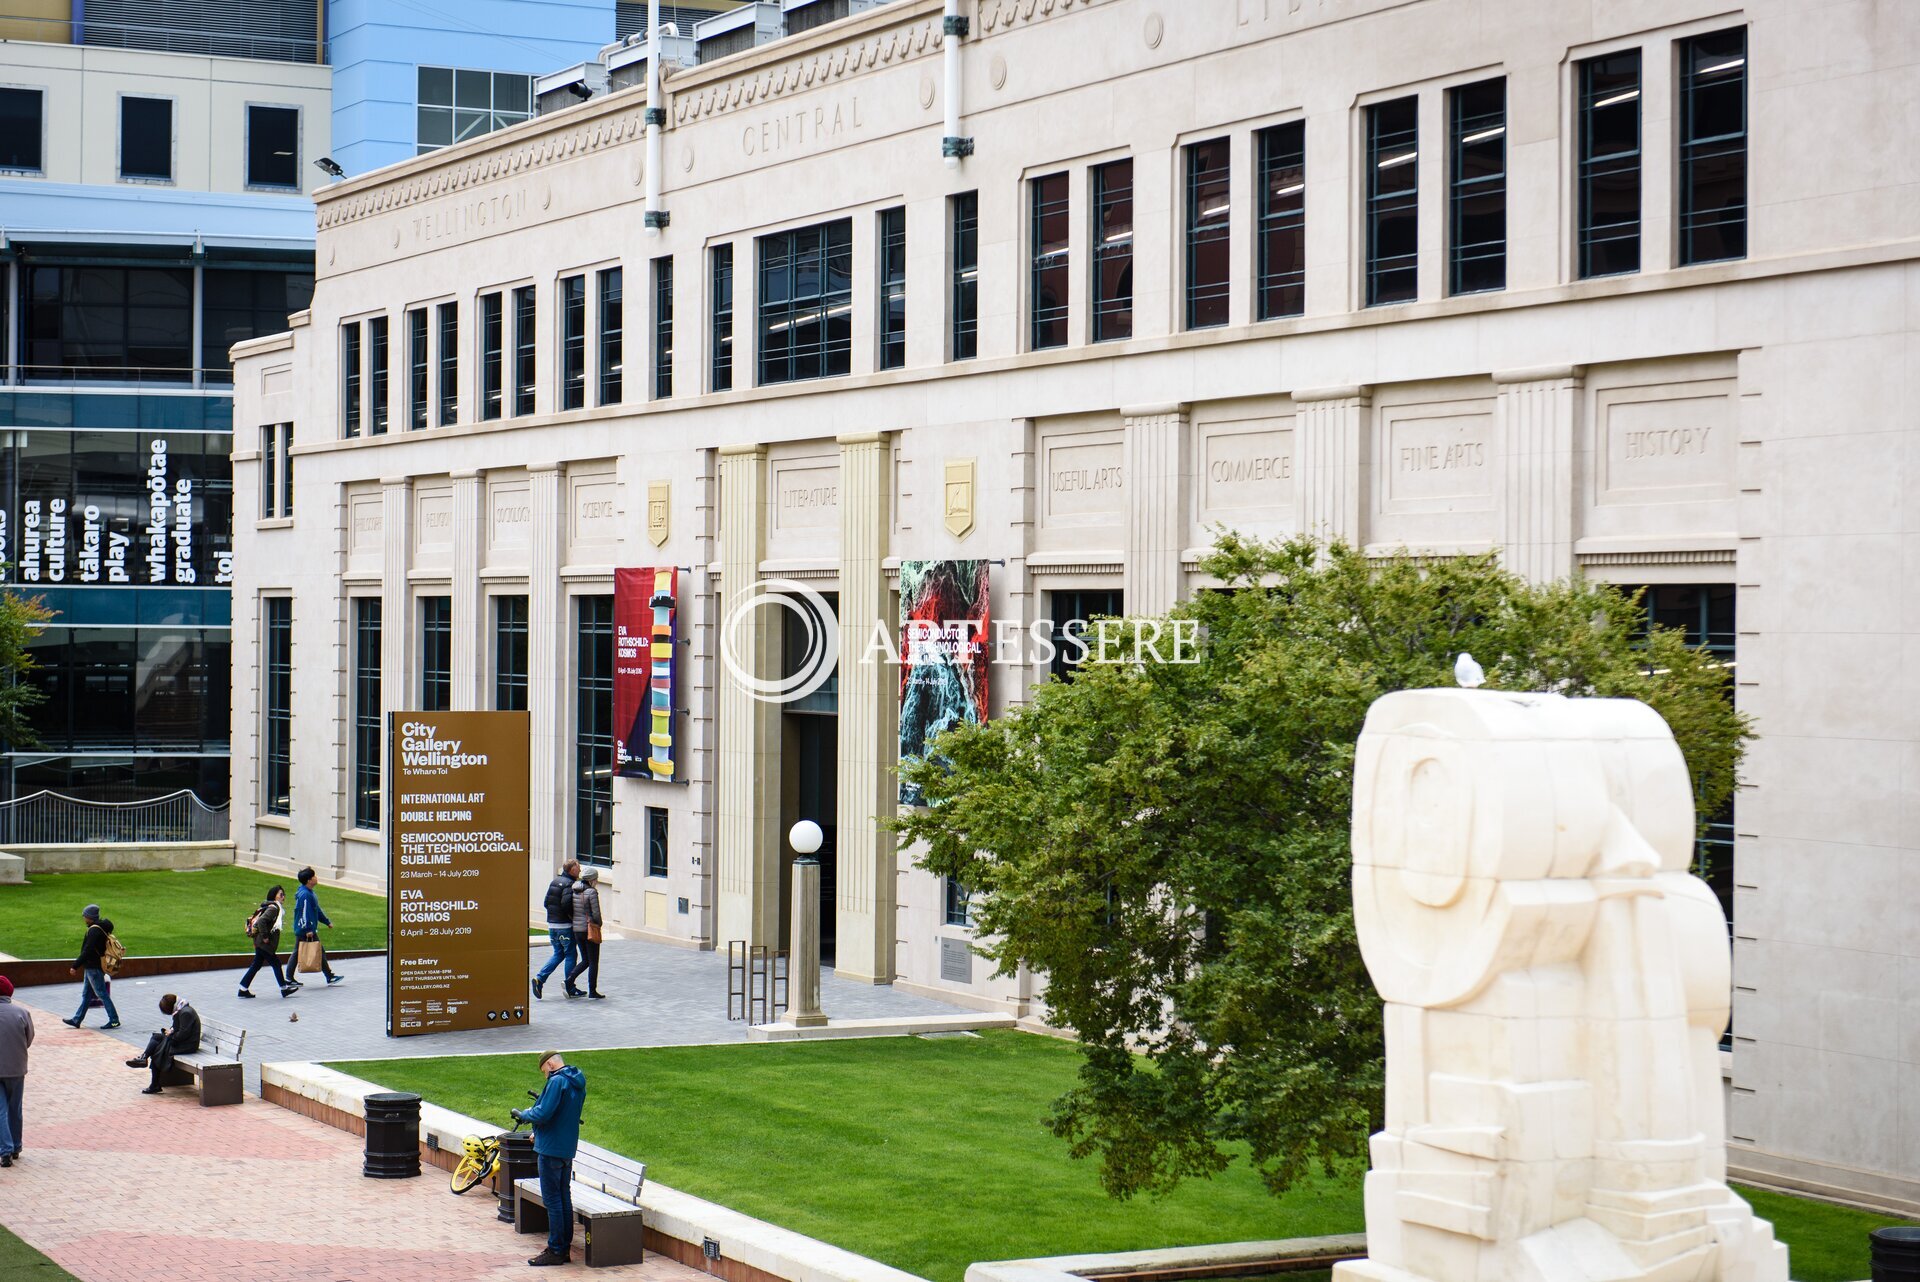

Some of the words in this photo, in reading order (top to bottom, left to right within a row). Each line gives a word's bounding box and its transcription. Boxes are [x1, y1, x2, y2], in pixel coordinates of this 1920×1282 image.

[743, 96, 862, 156] CENTRAL
[413, 189, 526, 240] WELLINGTON
[1625, 427, 1712, 459] HISTORY
[1400, 445, 1438, 472] FINE
[1442, 442, 1484, 469] ARTS
[1211, 456, 1290, 483] COMMERCE
[1052, 469, 1091, 492] USEFUL
[1092, 466, 1123, 490] ARTS
[784, 487, 837, 508] LITERATURE
[146, 439, 171, 583] whakapōtae
[582, 501, 612, 518] SCIENCE
[171, 479, 196, 584] graduate
[19, 500, 40, 582] ahurea
[44, 499, 66, 582] culture
[79, 505, 100, 582] tākaro
[104, 532, 130, 582] play
[618, 626, 628, 636] EVA
[402, 722, 436, 738] City
[402, 737, 461, 754] Gallery
[402, 751, 488, 768] Wellington
[401, 793, 467, 804] INTERNATIONAL
[468, 793, 485, 803] ART
[401, 811, 434, 822] DOUBLE
[436, 810, 472, 822] HELPING
[401, 832, 504, 843] SEMICONDUCTOR:
[401, 844, 424, 854] THE
[426, 842, 523, 853] TECHNOLOGICAL
[401, 854, 452, 865] SUBLIME
[400, 890, 424, 900] EVA
[400, 901, 479, 912] ROTHSCHILD:
[400, 912, 450, 923] KOSMOS
[407, 929, 423, 937] April
